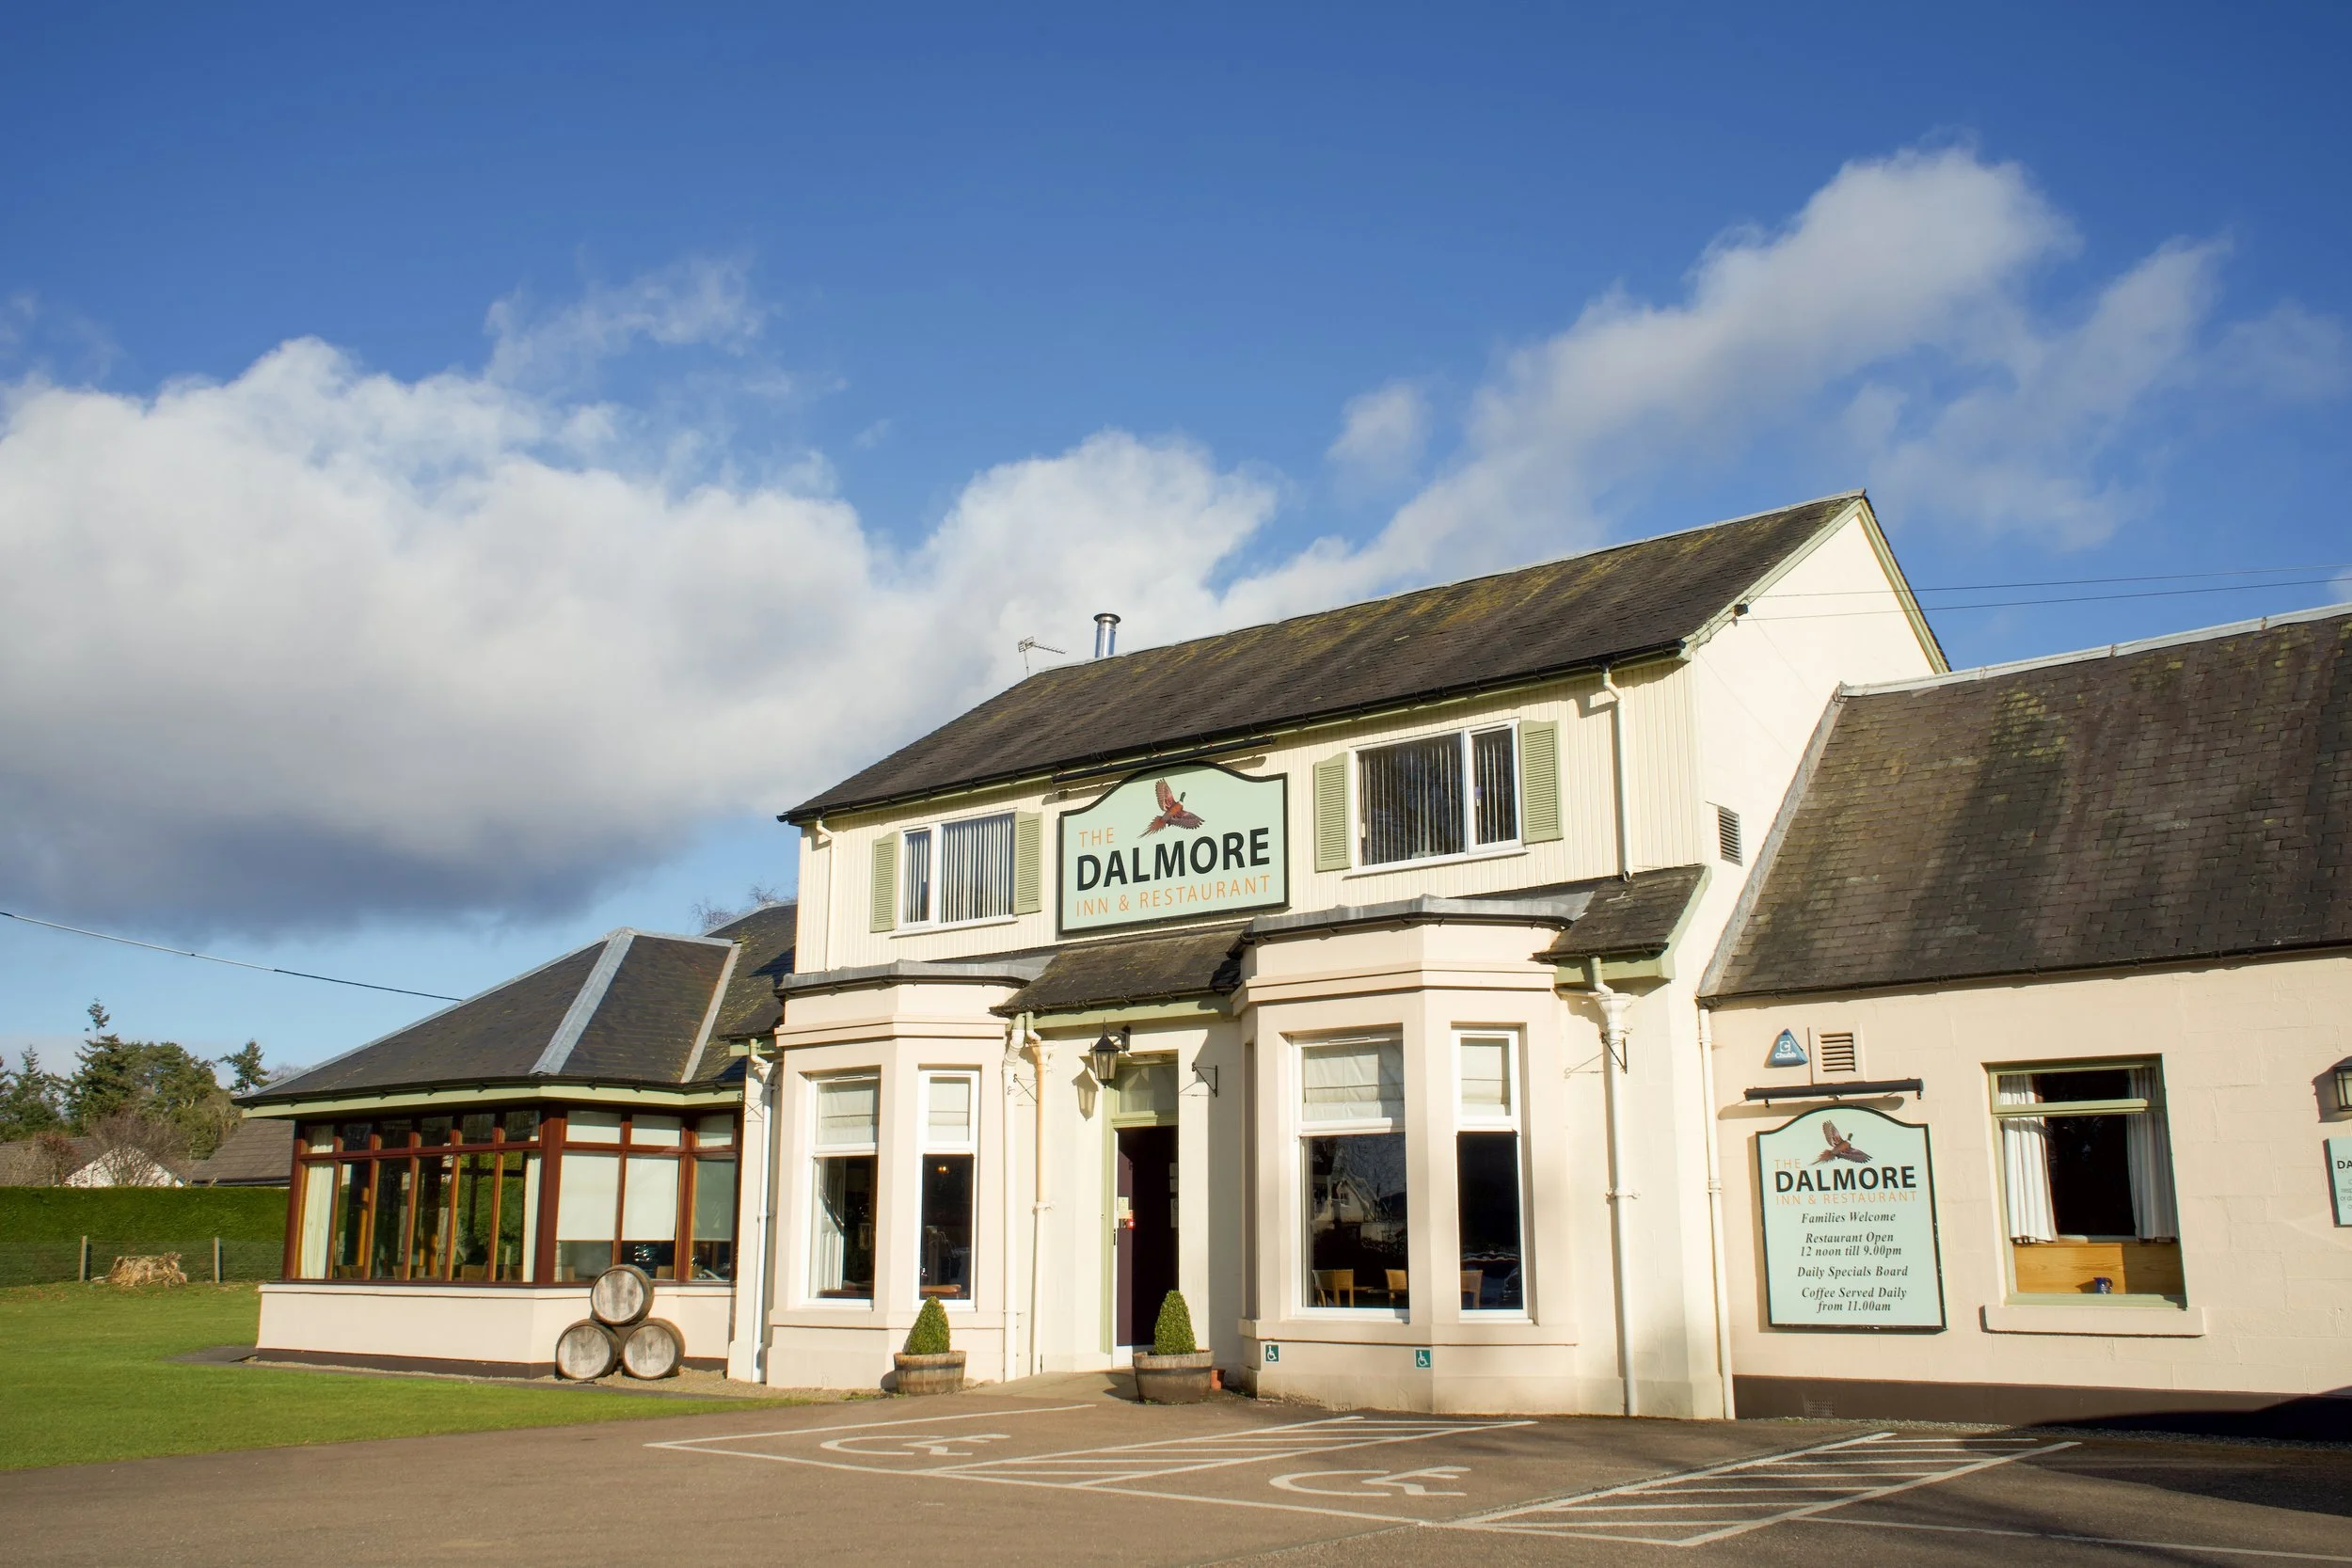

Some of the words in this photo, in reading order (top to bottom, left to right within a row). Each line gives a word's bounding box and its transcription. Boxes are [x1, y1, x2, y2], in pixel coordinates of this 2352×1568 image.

[1079, 827, 1115, 847] THE
[1076, 827, 1270, 892] DALMORE
[1076, 898, 1109, 917] INN
[1119, 895, 1129, 911] &
[1139, 875, 1270, 909] RESTAURANT
[1774, 1158, 1801, 1169] THE
[1775, 1165, 1917, 1193] DALMORE
[1775, 1195, 1801, 1205] INN
[1807, 1195, 1817, 1205] &
[1823, 1191, 1917, 1205] RESTAURANT
[1801, 1212, 1846, 1224] Families
[1850, 1211, 1897, 1223] Welcome
[1805, 1232, 1863, 1243] Restaurant
[1866, 1231, 1894, 1244] Open
[1801, 1245, 1812, 1257] 12
[1815, 1247, 1841, 1257] noon
[1845, 1245, 1860, 1256] till
[1863, 1244, 1901, 1259] 9.00pm
[1797, 1266, 1825, 1279] Daily
[1828, 1265, 1872, 1279] Specials
[1875, 1265, 1909, 1276] Board
[1802, 1287, 1836, 1300] Coffee
[1837, 1287, 1875, 1298] Served
[1878, 1287, 1907, 1300] Daily
[1817, 1301, 1843, 1313] from
[1847, 1301, 1891, 1311] 11.00am
